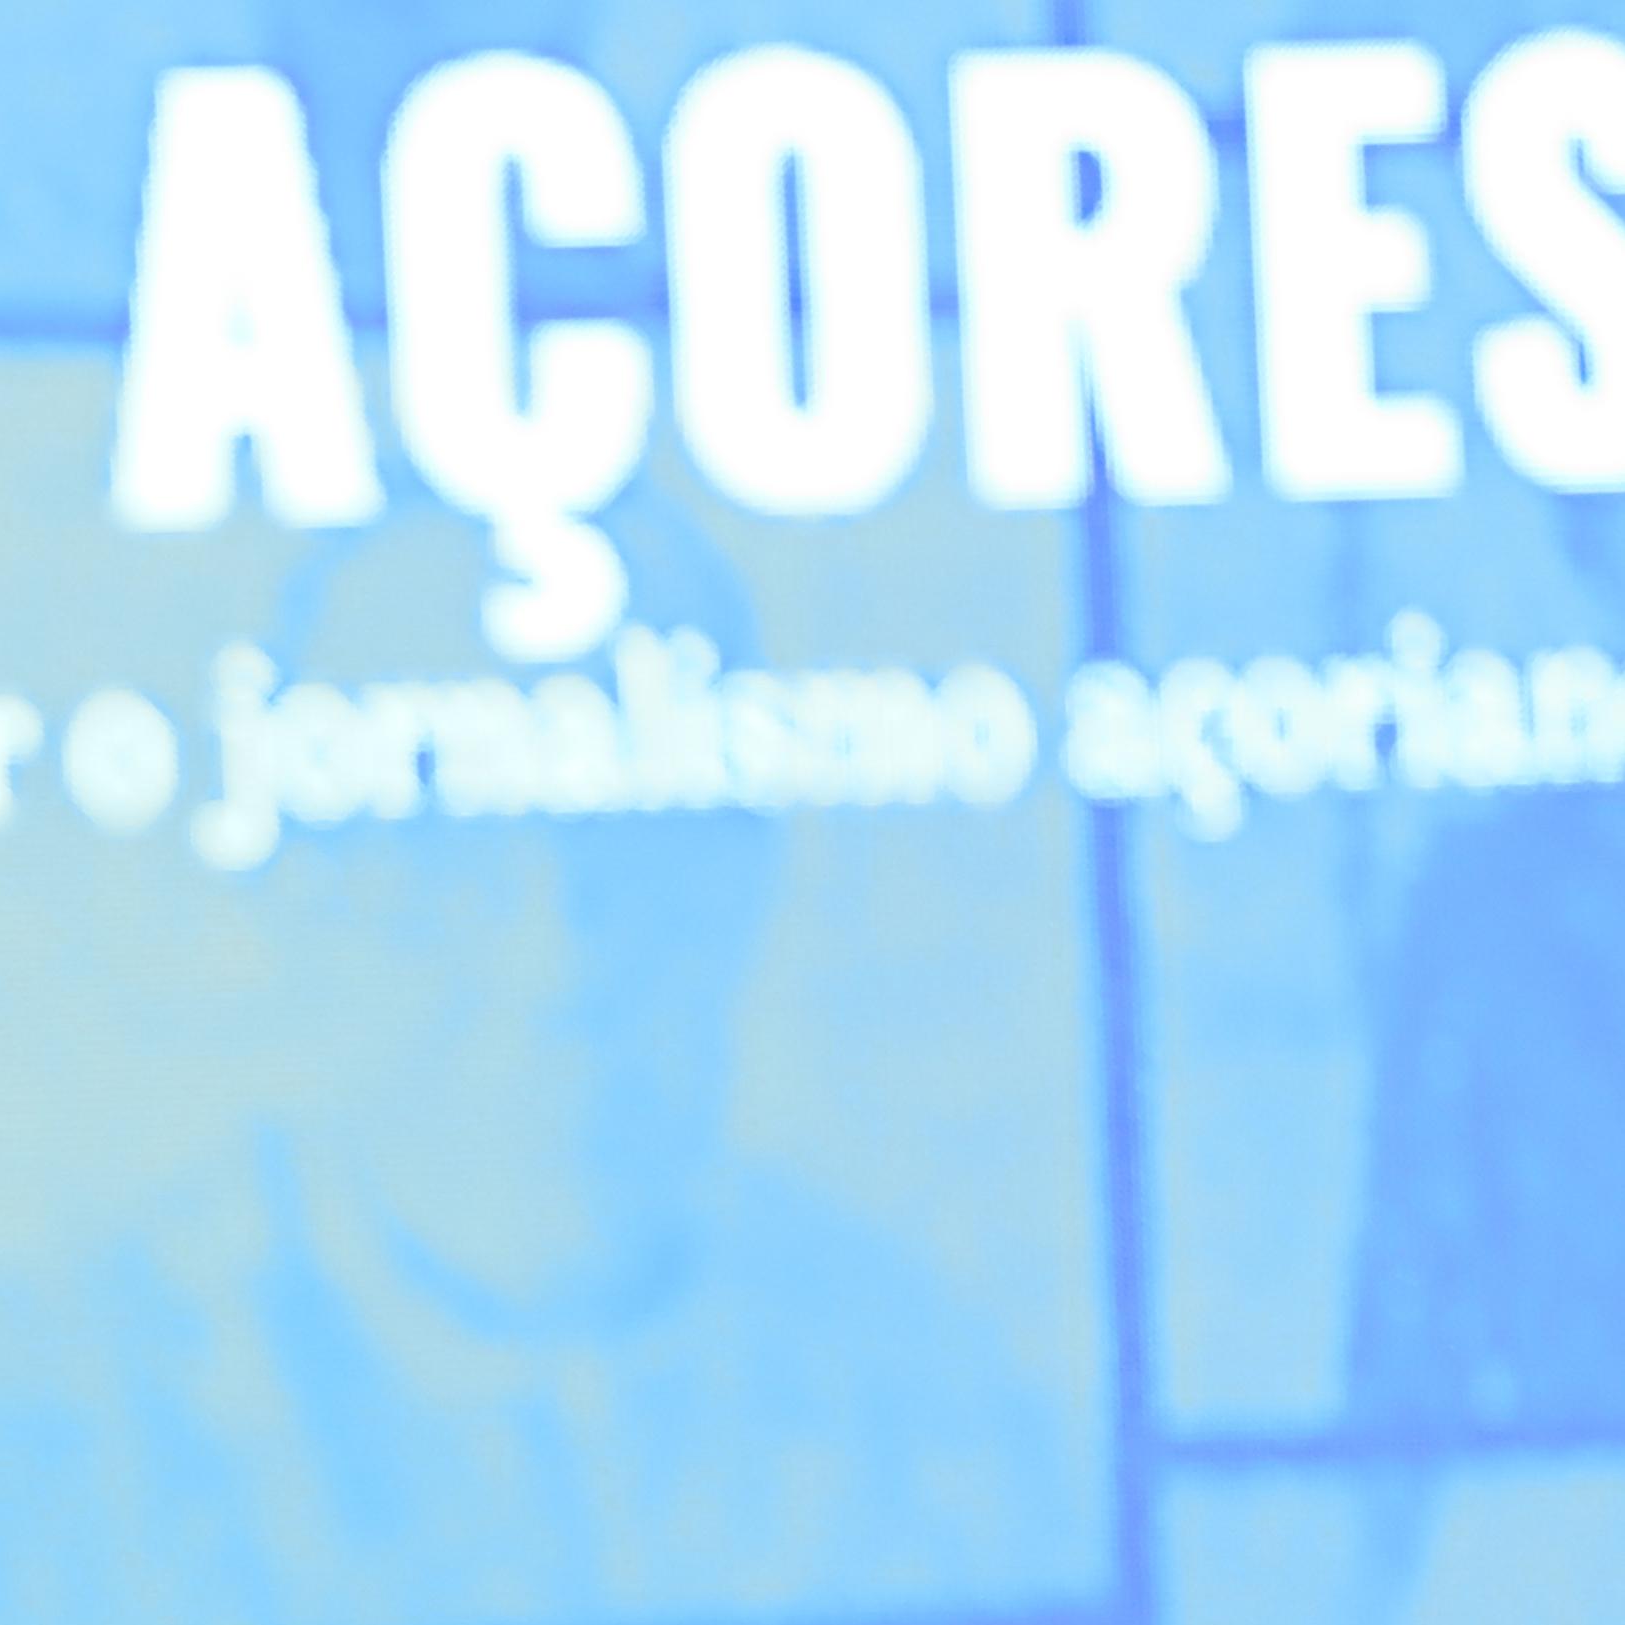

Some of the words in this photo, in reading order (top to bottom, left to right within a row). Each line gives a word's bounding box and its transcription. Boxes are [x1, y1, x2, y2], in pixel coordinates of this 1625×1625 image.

[107, 25, 1625, 664] AÇORES
[62, 688, 180, 833] o
[190, 624, 1039, 872] jornalismo
